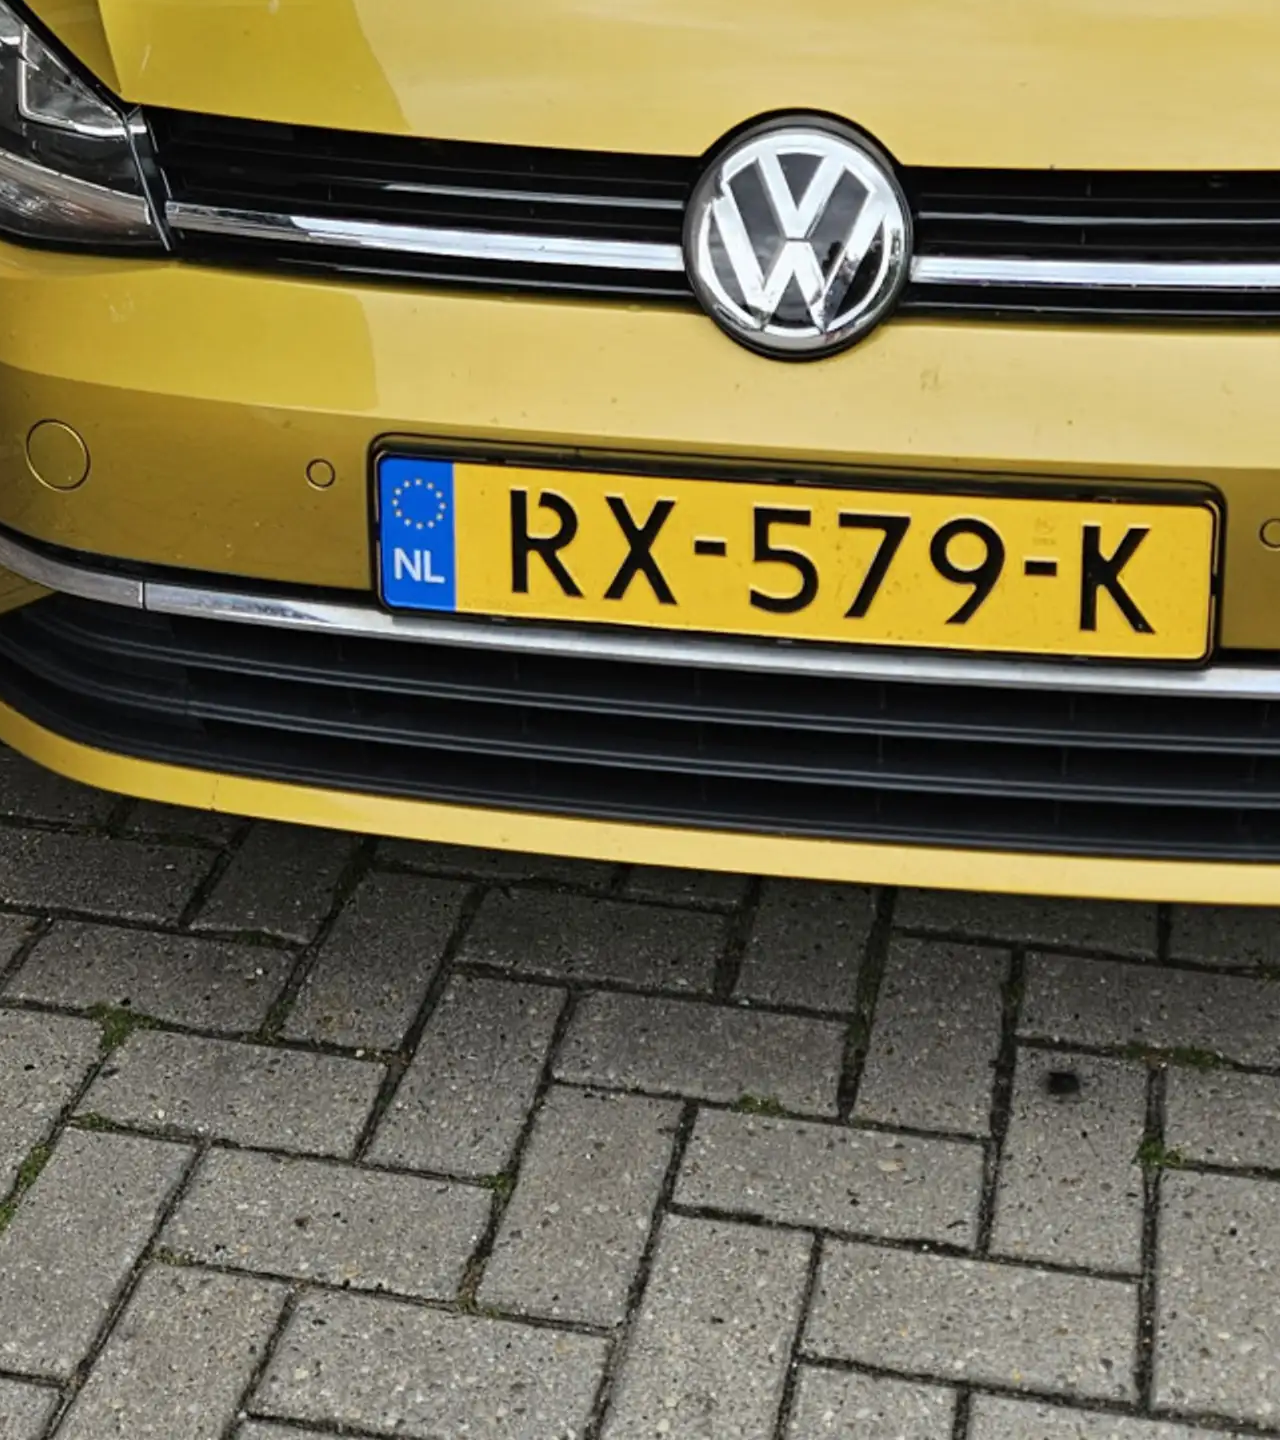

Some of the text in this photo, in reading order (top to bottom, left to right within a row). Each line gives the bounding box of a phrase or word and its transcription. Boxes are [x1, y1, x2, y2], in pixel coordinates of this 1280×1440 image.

[702, 134, 900, 342] VW
[392, 546, 447, 585] NL
[509, 488, 1157, 637] RX-579-K
